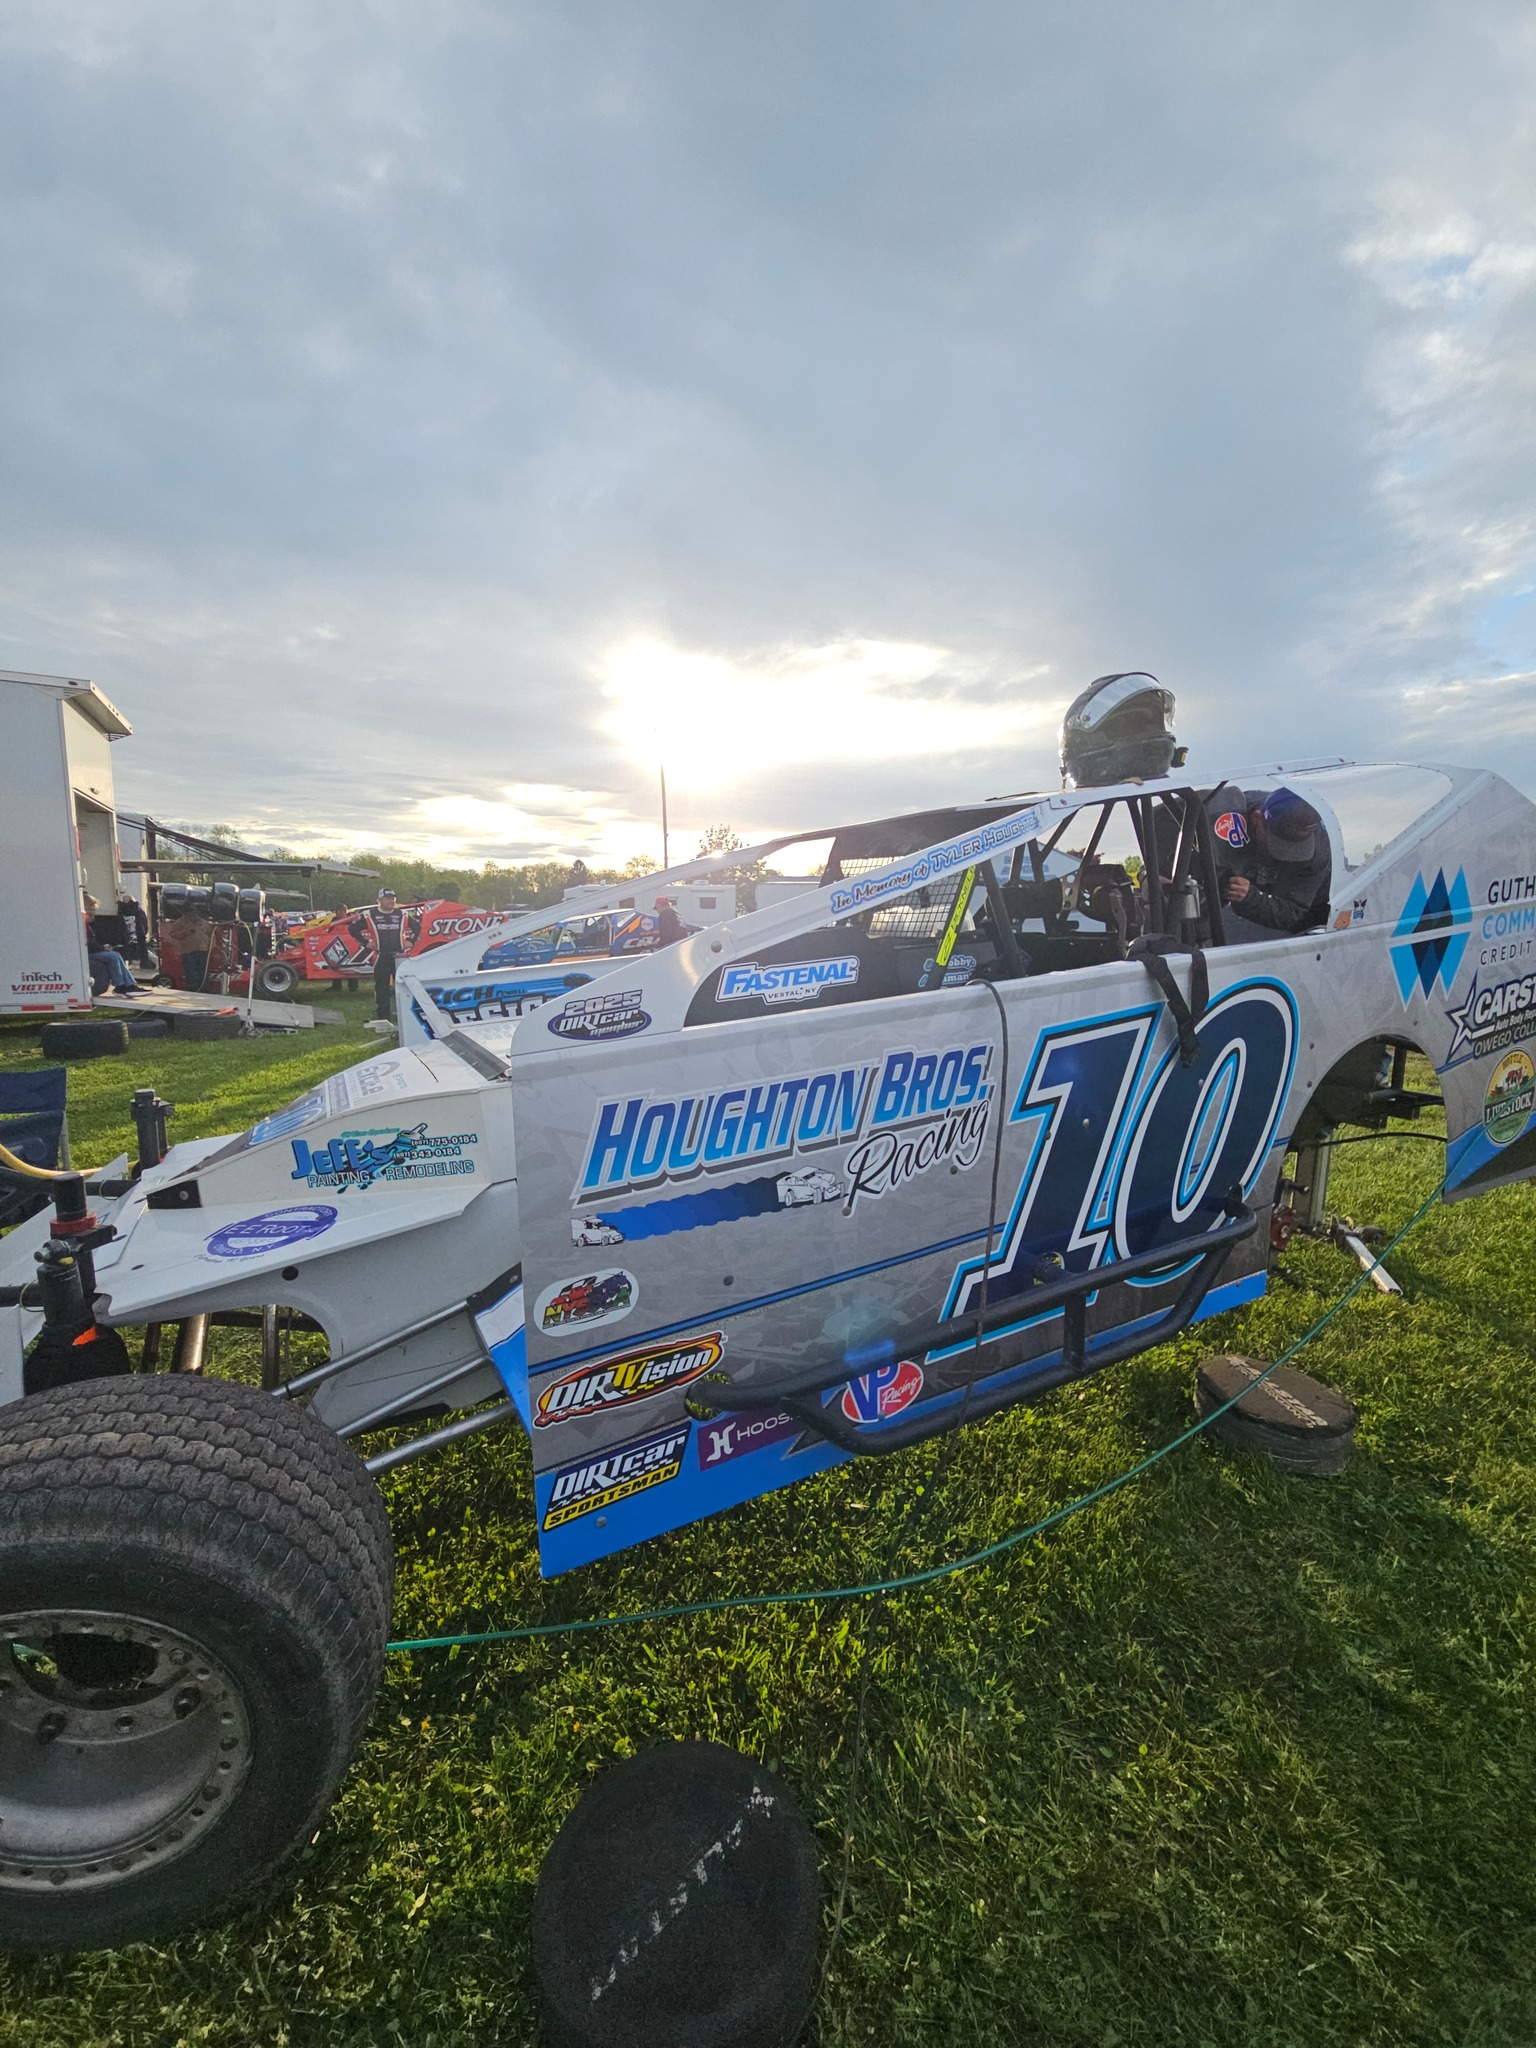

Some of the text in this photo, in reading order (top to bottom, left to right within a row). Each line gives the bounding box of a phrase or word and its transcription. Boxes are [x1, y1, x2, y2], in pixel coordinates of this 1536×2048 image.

[833, 894, 851, 909] In
[855, 871, 910, 899] Memory
[914, 862, 928, 876] of
[931, 839, 981, 868] TYLER
[1487, 875, 1536, 905] GUTH
[1482, 908, 1535, 940] COMM
[1480, 940, 1532, 966] CREDIT
[11, 983, 73, 992] VICTORY
[21, 972, 62, 982] inTech
[723, 961, 853, 996] FASTENAL
[565, 989, 642, 1017] 2025
[590, 1020, 643, 1037] member
[1495, 1017, 1509, 1032] Auto
[1510, 1012, 1523, 1027] Body
[1475, 1030, 1512, 1057] OWEGO
[582, 1044, 988, 1189] HOUGHTON BROS.
[847, 1101, 990, 1205] Racing
[939, 976, 1300, 1337] 10
[307, 1169, 370, 1188] PAINTING
[385, 1160, 475, 1181] REMODELING
[849, 1363, 922, 1422] VP Racing
[736, 1412, 794, 1441] HOOS
[549, 1465, 676, 1526] SPORTSMAN
